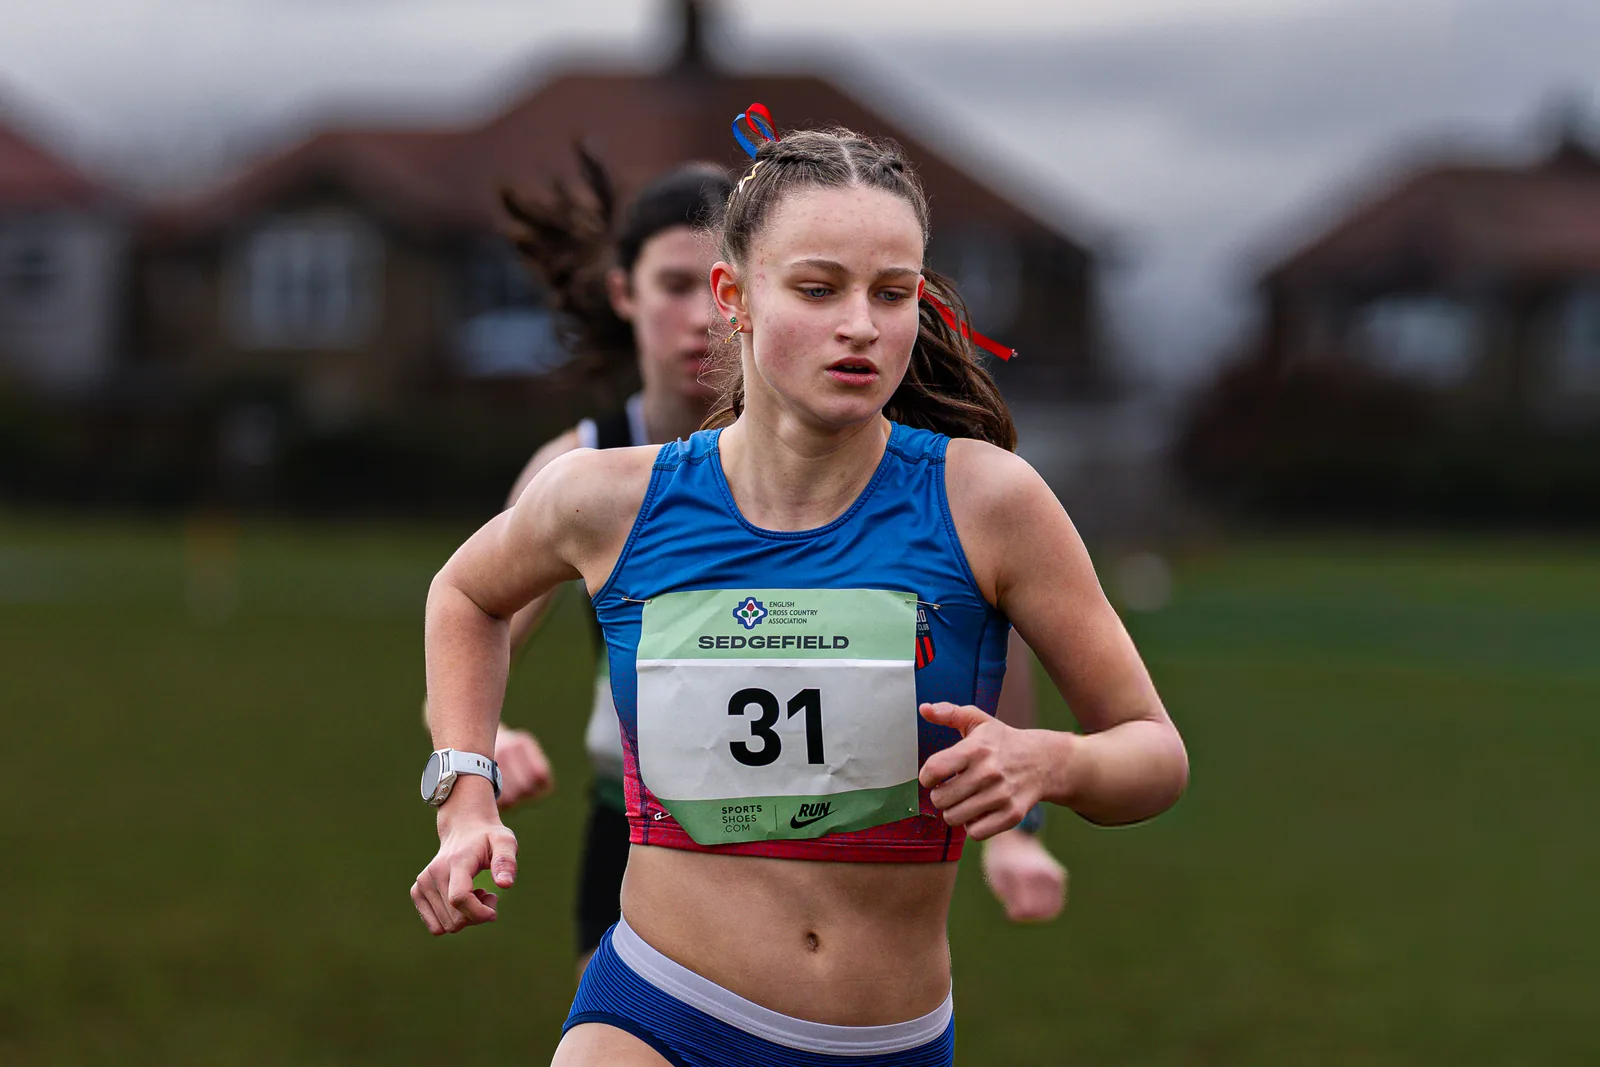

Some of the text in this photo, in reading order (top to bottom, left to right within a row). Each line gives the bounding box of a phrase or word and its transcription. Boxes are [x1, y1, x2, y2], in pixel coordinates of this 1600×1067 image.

[698, 635, 850, 650] SEDGEFIELD
[727, 687, 825, 767] 31
[721, 804, 763, 814] SPORTS
[798, 802, 832, 818] RUN
[722, 814, 757, 824] SHOES
[723, 824, 750, 834] .COM
